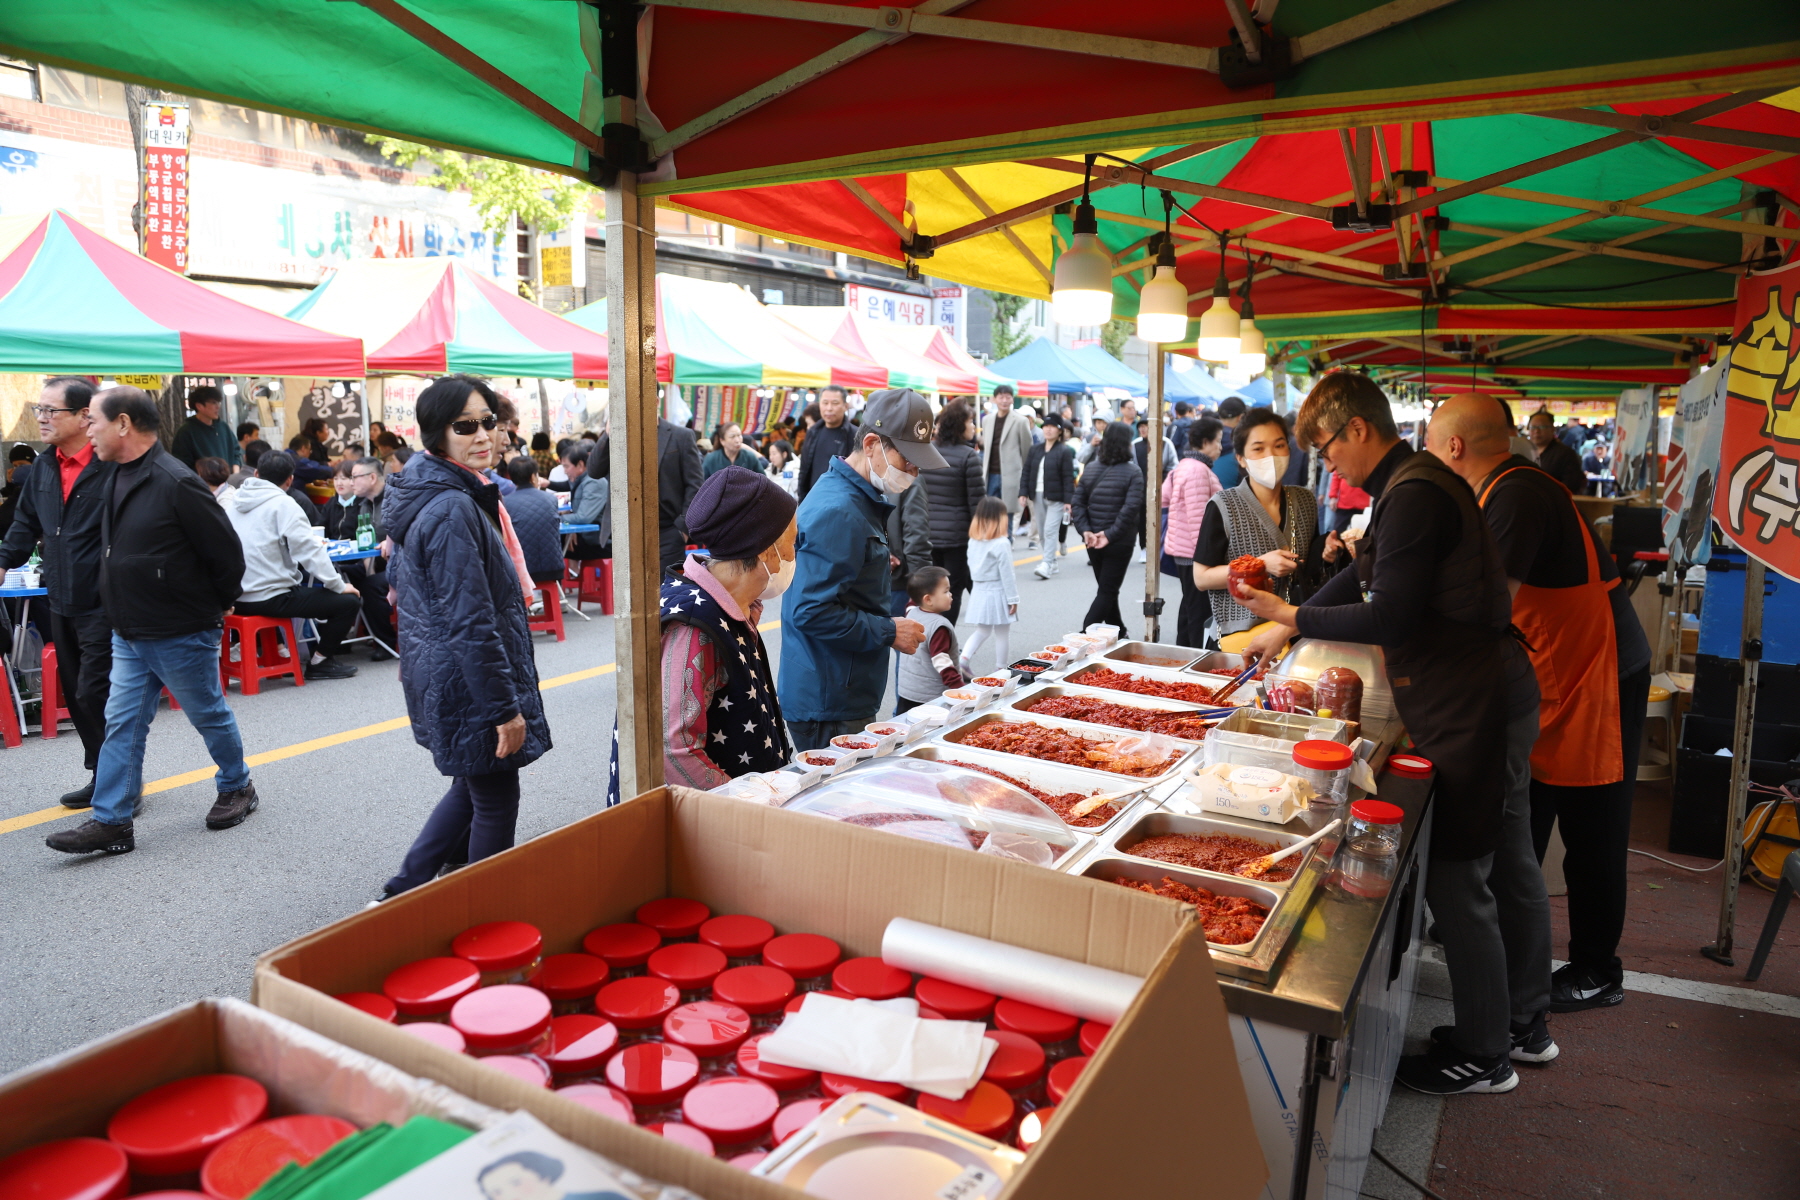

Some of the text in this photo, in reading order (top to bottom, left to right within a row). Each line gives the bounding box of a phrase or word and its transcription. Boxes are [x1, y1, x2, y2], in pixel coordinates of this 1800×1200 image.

[149, 129, 186, 145] 대원카
[148, 153, 160, 233] 부동액교환
[175, 155, 187, 268] 에어콘가스주입
[1215, 796, 1232, 808] 150
[1312, 1130, 1329, 1162] STEEL
